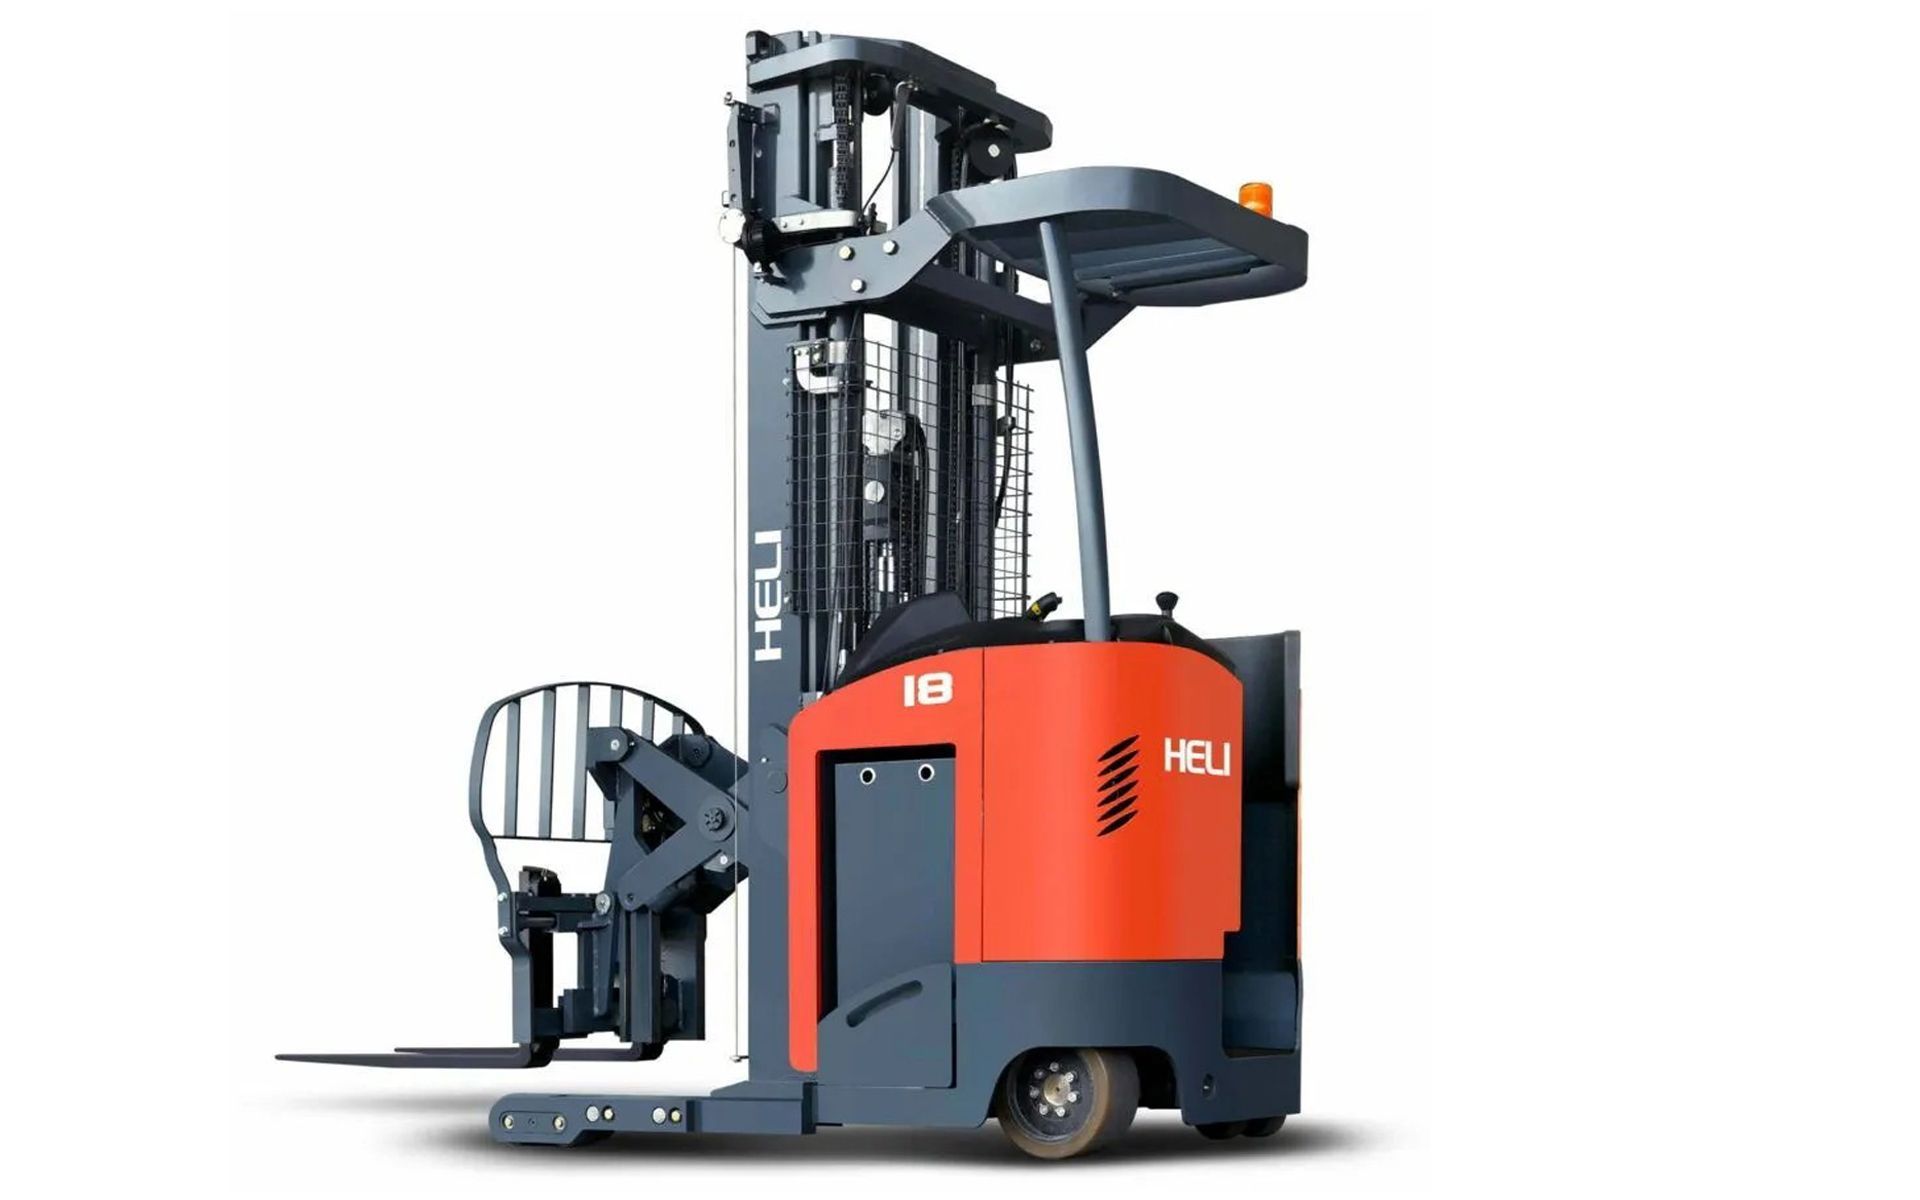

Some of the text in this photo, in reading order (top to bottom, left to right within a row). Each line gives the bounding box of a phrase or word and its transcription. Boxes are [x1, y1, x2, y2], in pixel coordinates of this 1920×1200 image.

[754, 530, 782, 661] HELI
[903, 672, 952, 706] 18
[1165, 738, 1230, 775] HELI
